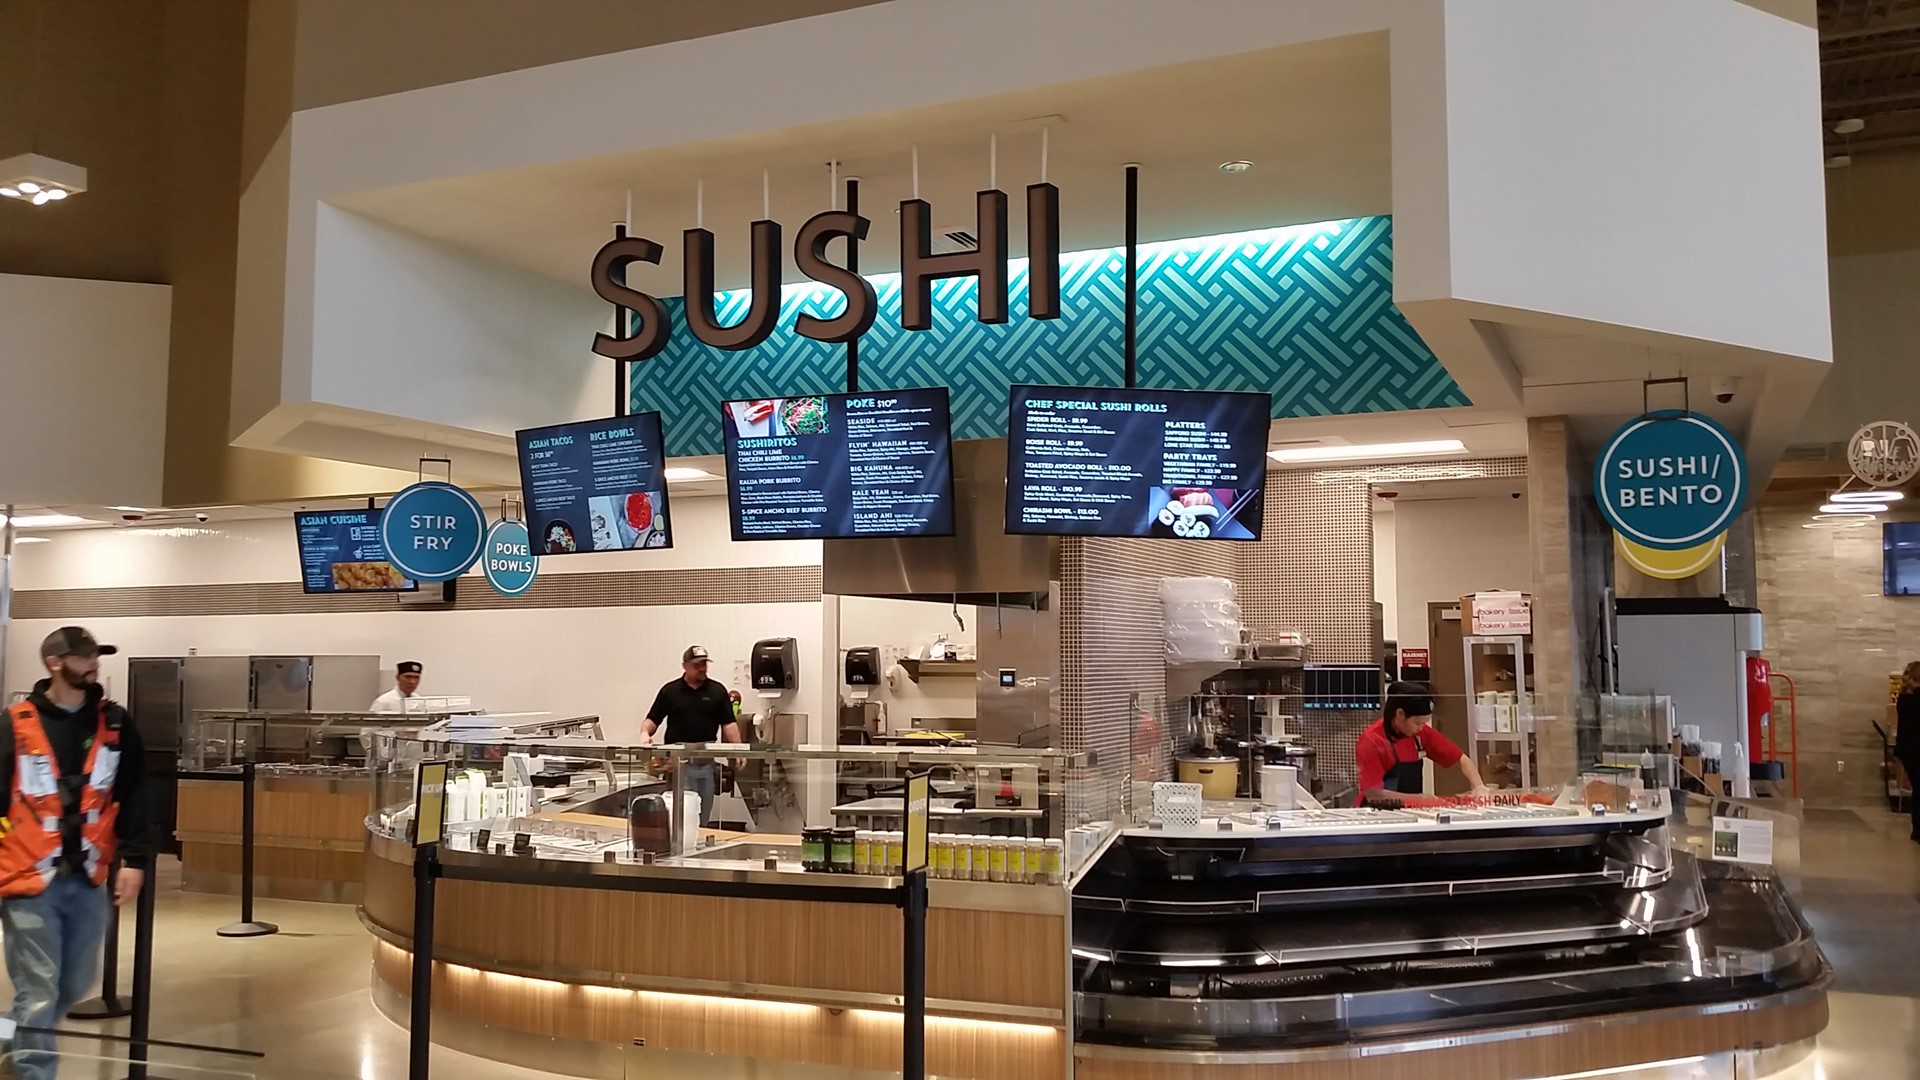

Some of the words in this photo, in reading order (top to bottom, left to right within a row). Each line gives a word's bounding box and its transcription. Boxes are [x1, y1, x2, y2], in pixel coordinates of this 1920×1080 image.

[591, 183, 1060, 361] SUSHI
[846, 398, 875, 408] POKE
[1025, 400, 1053, 409] CHEF
[1055, 401, 1098, 410] SPECIAL
[1100, 402, 1132, 411] SUSHI
[1134, 404, 1168, 412] ROLLS
[1165, 421, 1206, 429] PLATTERS
[590, 431, 607, 441] RICE
[608, 428, 635, 438] BOWLS
[528, 439, 550, 449] ASIAN
[550, 436, 574, 446] TACOS
[737, 437, 797, 448] SUSHIRITOS
[1618, 454, 1720, 479] SUSHI/
[1620, 484, 1722, 507] BENTO
[301, 516, 327, 525] ASIAN
[330, 515, 367, 524] CUISINE
[410, 515, 456, 530] STIR
[413, 536, 453, 550] FRY
[496, 543, 527, 556] POKE
[491, 559, 531, 573] BOWLS
[1494, 794, 1521, 806] DAILY
